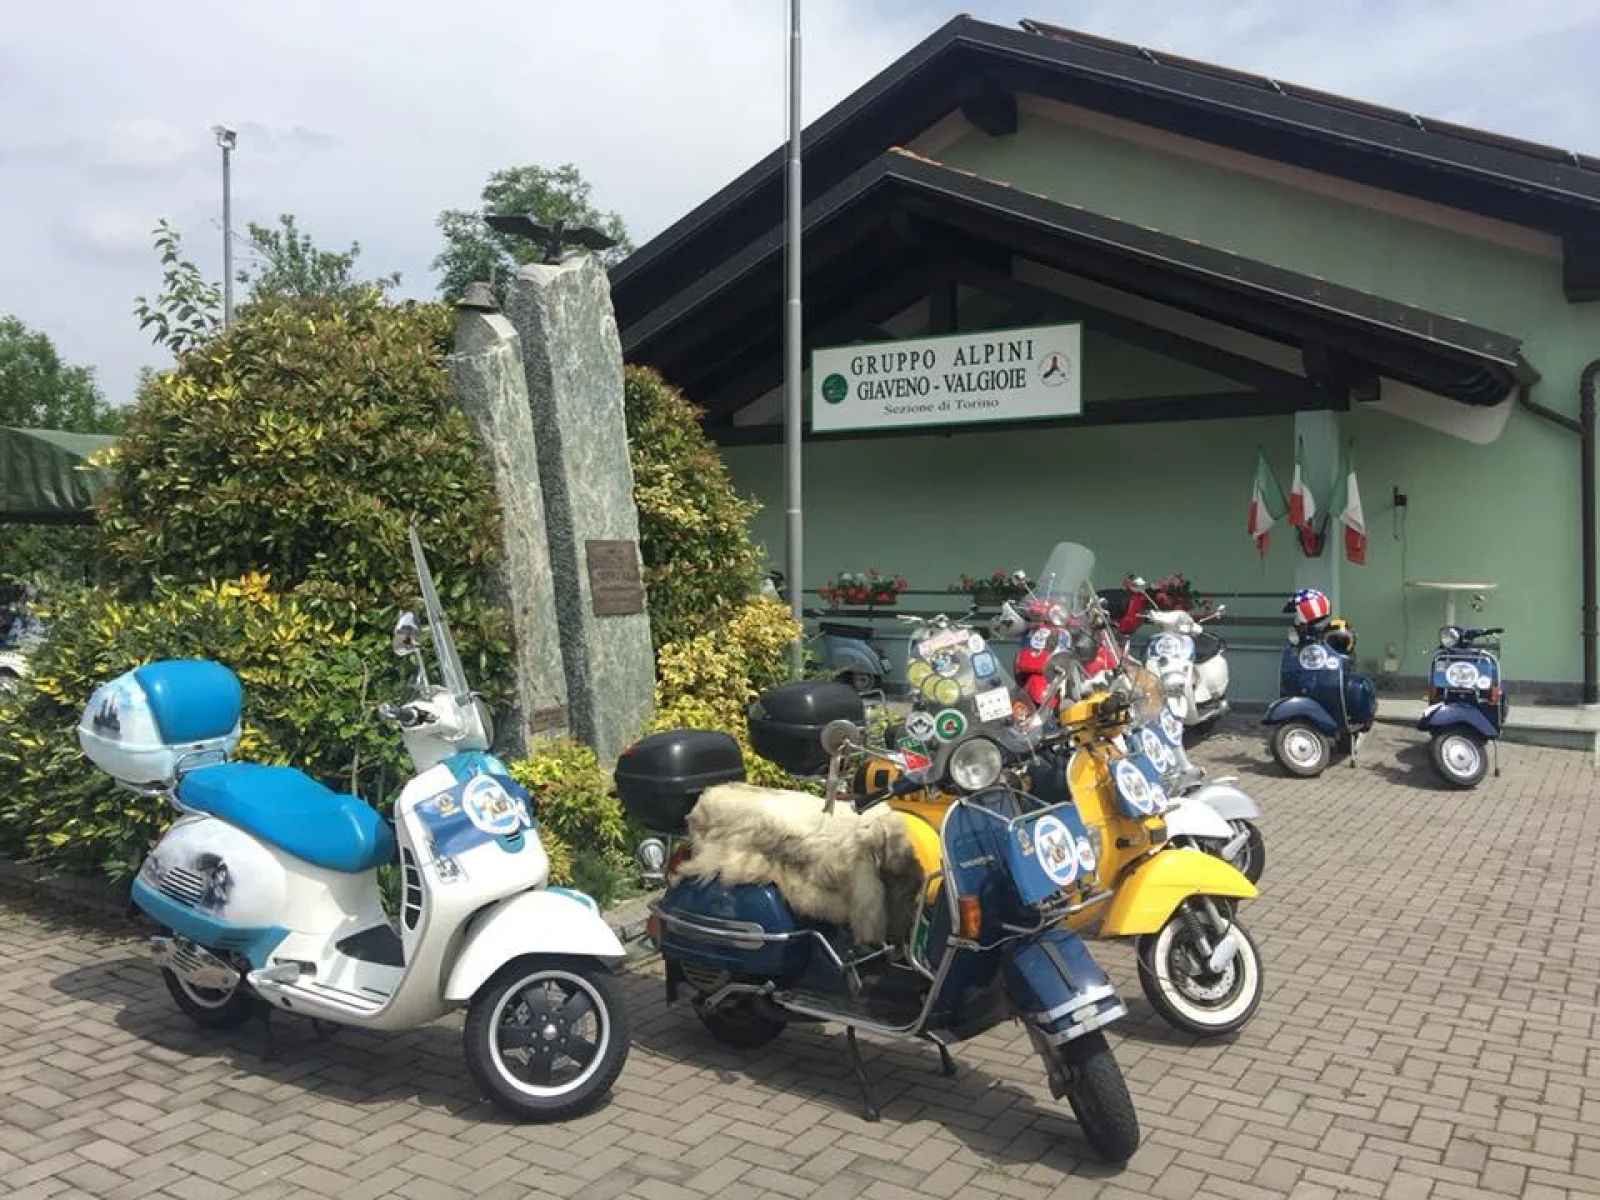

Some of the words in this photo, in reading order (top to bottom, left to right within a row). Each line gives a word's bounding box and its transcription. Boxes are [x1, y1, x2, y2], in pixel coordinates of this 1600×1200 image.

[851, 349, 936, 376] GRUPPO
[953, 340, 1034, 367] ALPINI
[857, 376, 931, 401] GIAVENO
[943, 368, 1026, 394] VALGIOIE
[883, 402, 934, 415] Sezione
[937, 400, 951, 412] di
[955, 398, 1000, 410] Torino
